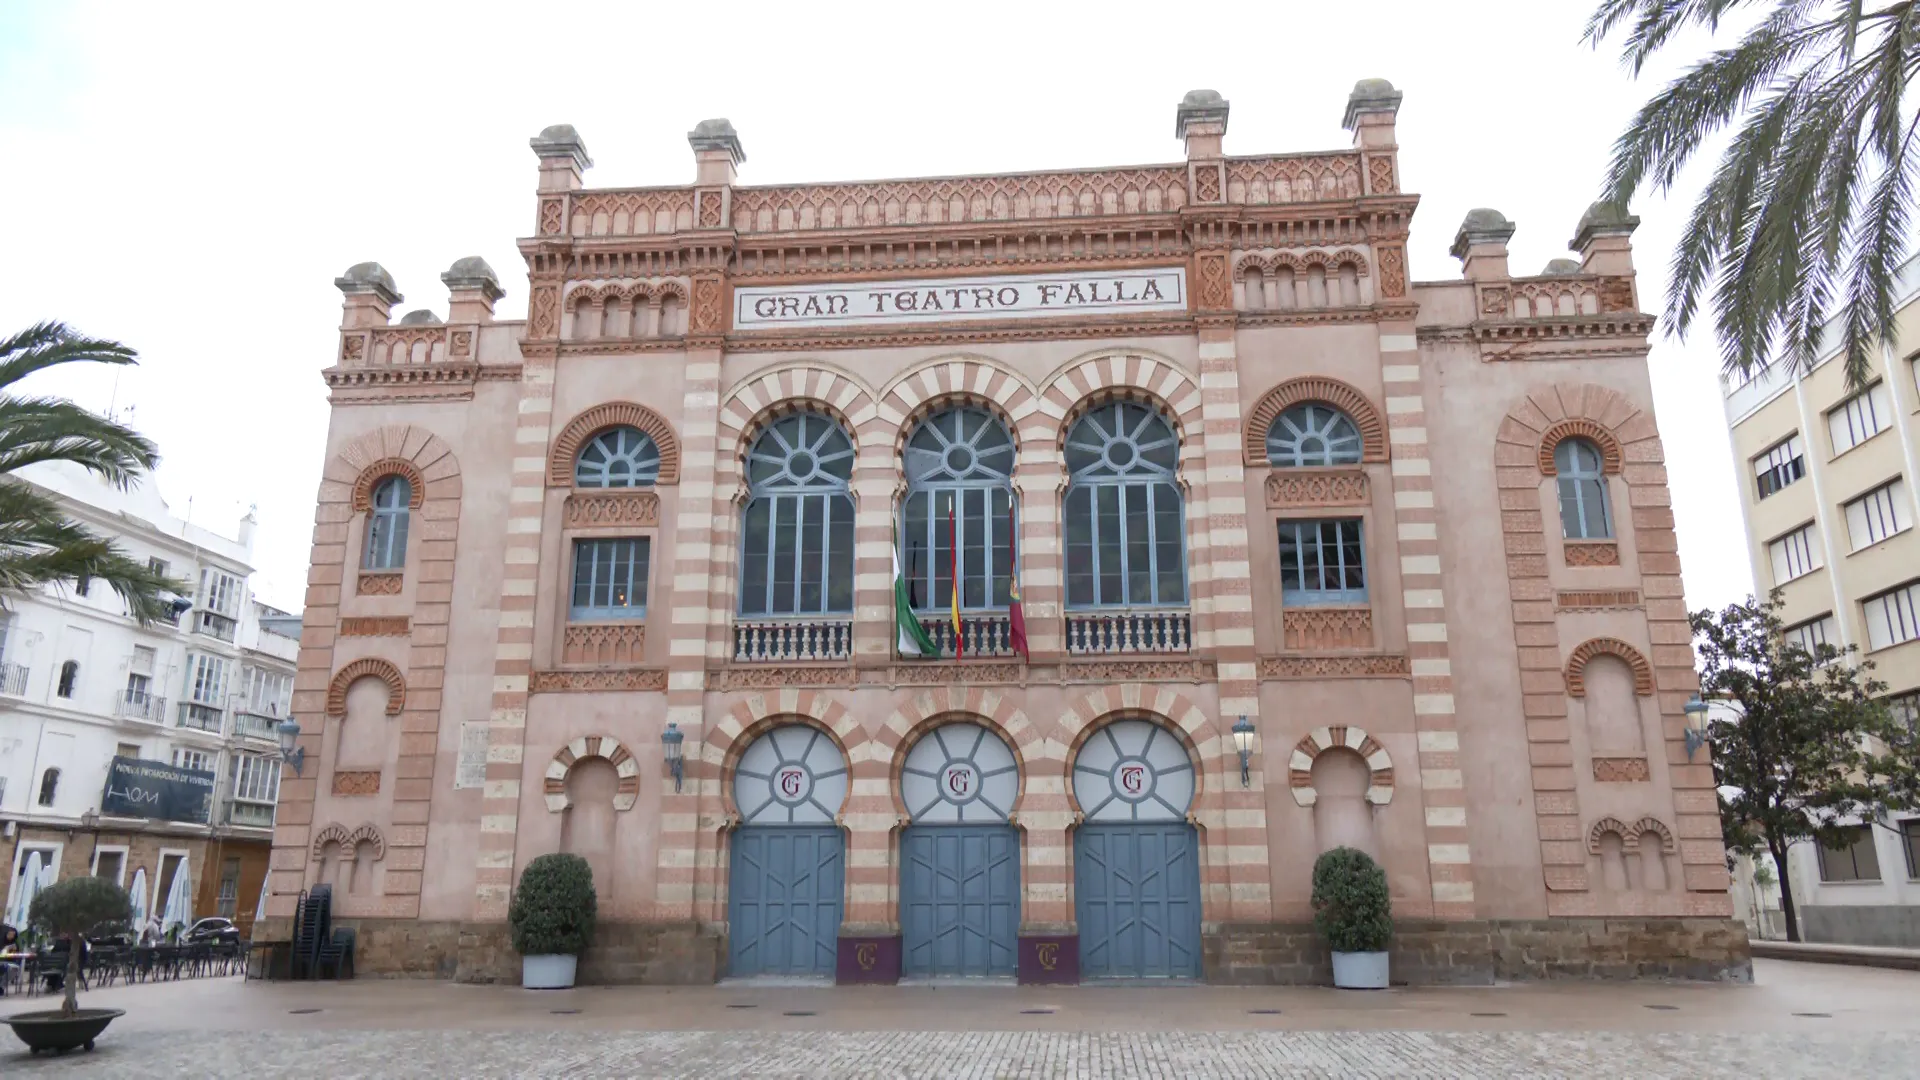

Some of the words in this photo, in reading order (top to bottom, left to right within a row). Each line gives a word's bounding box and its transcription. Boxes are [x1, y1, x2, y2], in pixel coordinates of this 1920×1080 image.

[754, 294, 849, 318] GRAN
[868, 286, 1020, 313] TEATRO
[1037, 278, 1164, 306] FALLA
